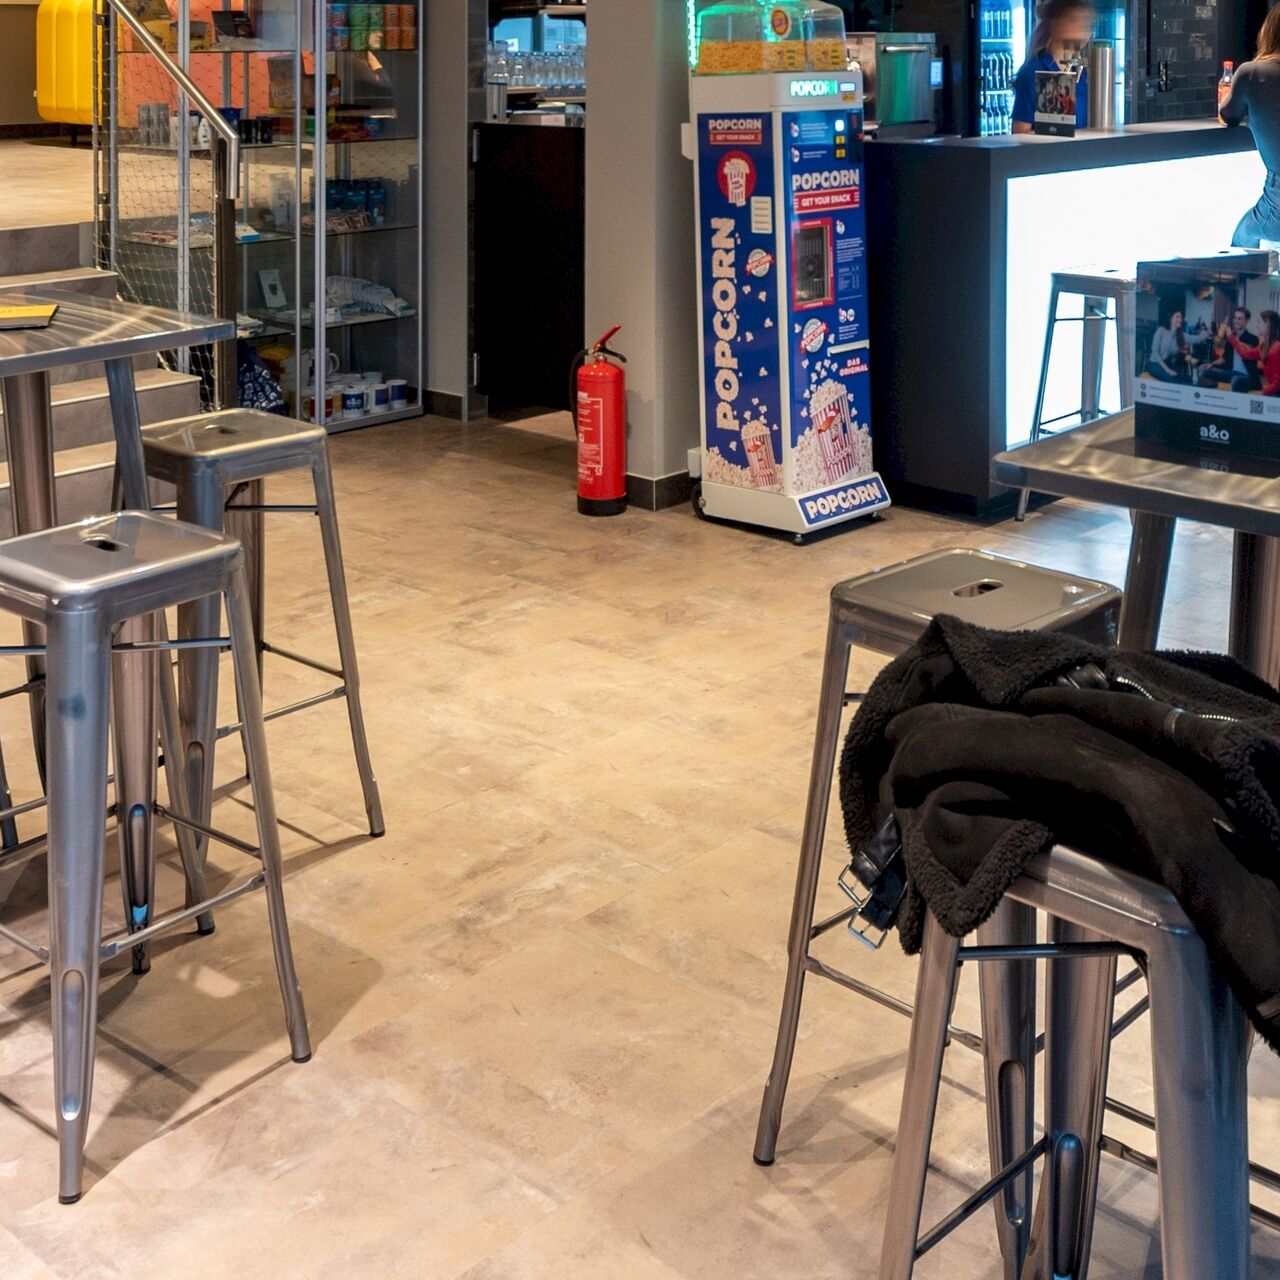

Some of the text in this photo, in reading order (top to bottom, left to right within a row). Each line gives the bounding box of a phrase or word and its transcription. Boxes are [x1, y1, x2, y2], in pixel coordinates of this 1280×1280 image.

[790, 80, 838, 96] POPCORN
[709, 118, 762, 130] POPCORN
[792, 169, 860, 190] POPCORN
[801, 193, 851, 207] GET YOUR SNACK
[710, 217, 740, 431] POPCORN
[839, 363, 868, 377] ORIGINAL
[847, 357, 860, 368] DAS
[1200, 424, 1229, 440] a&o
[805, 482, 882, 519] POPCORN
